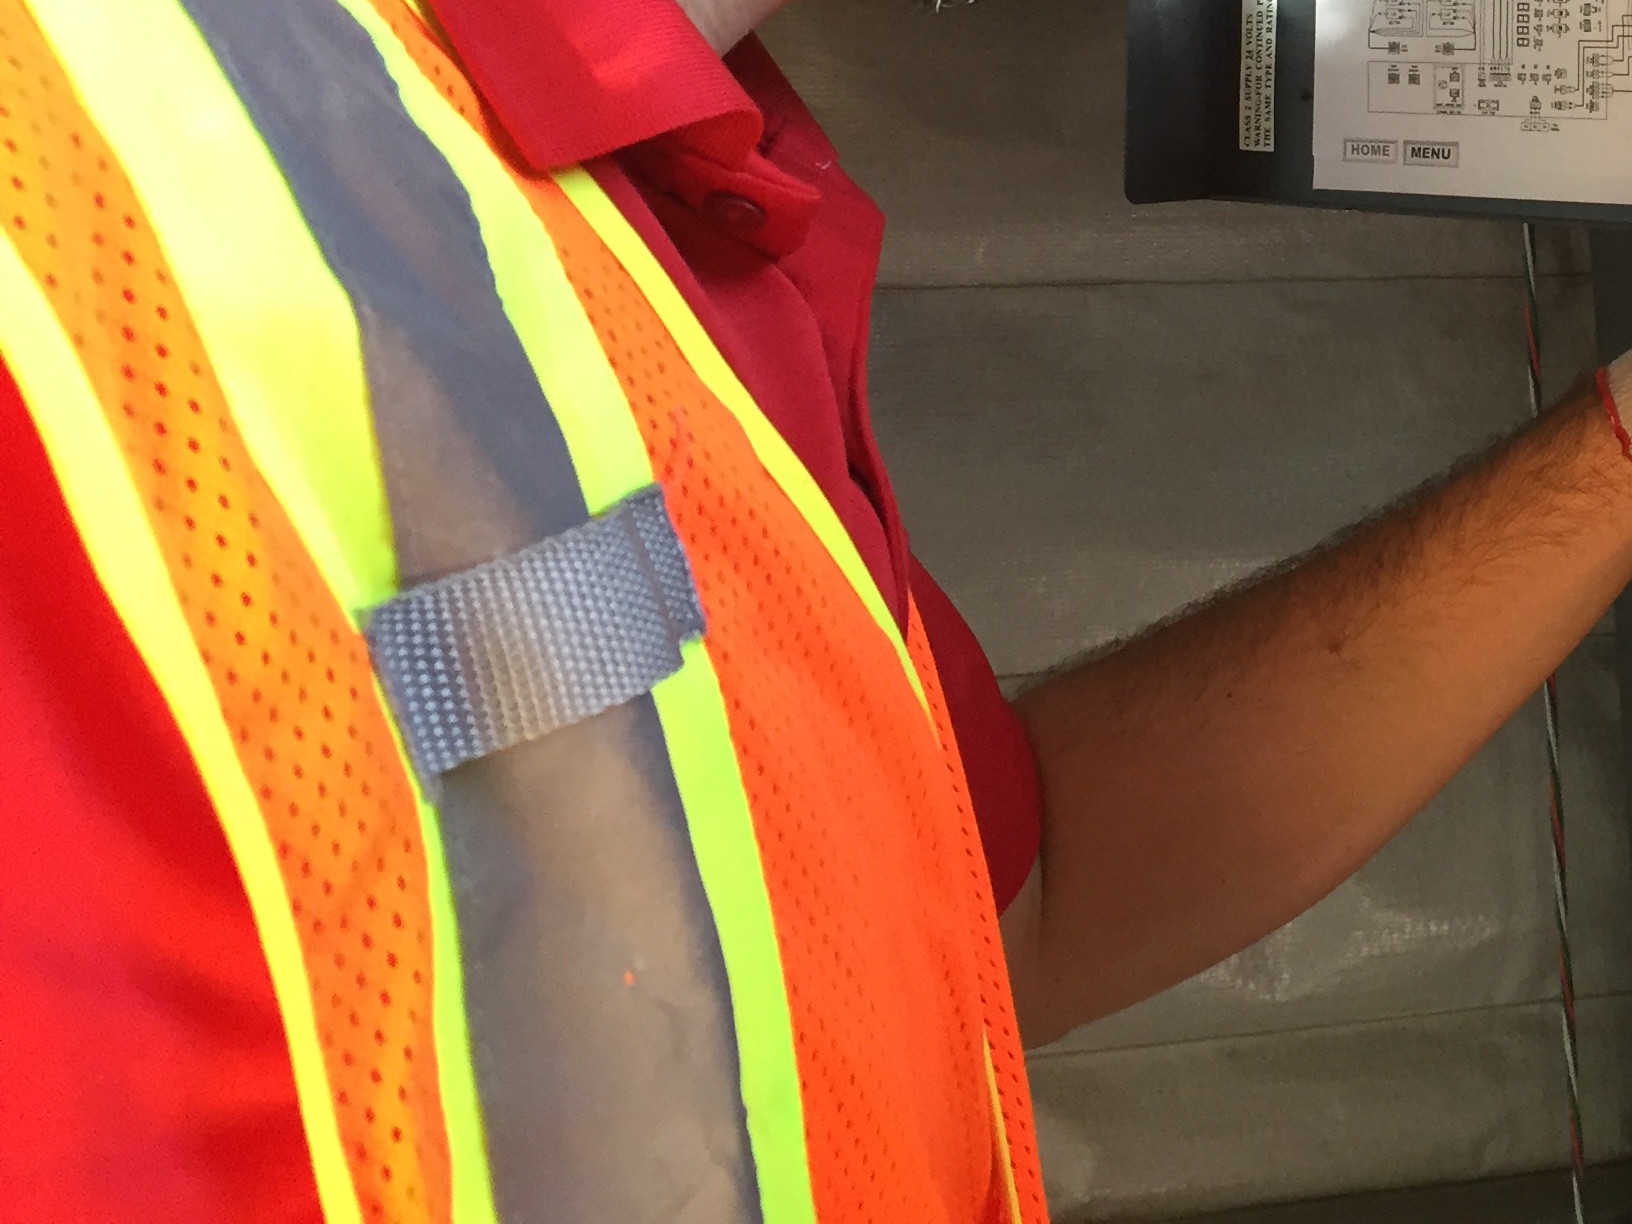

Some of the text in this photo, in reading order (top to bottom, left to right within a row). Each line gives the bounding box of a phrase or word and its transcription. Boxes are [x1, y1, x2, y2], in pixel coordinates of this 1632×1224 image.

[1256, 10, 1264, 71] CONTINUED
[1245, 66, 1253, 102] SUPPLY
[1351, 143, 1390, 157] HOME
[1411, 147, 1451, 160] MENU
